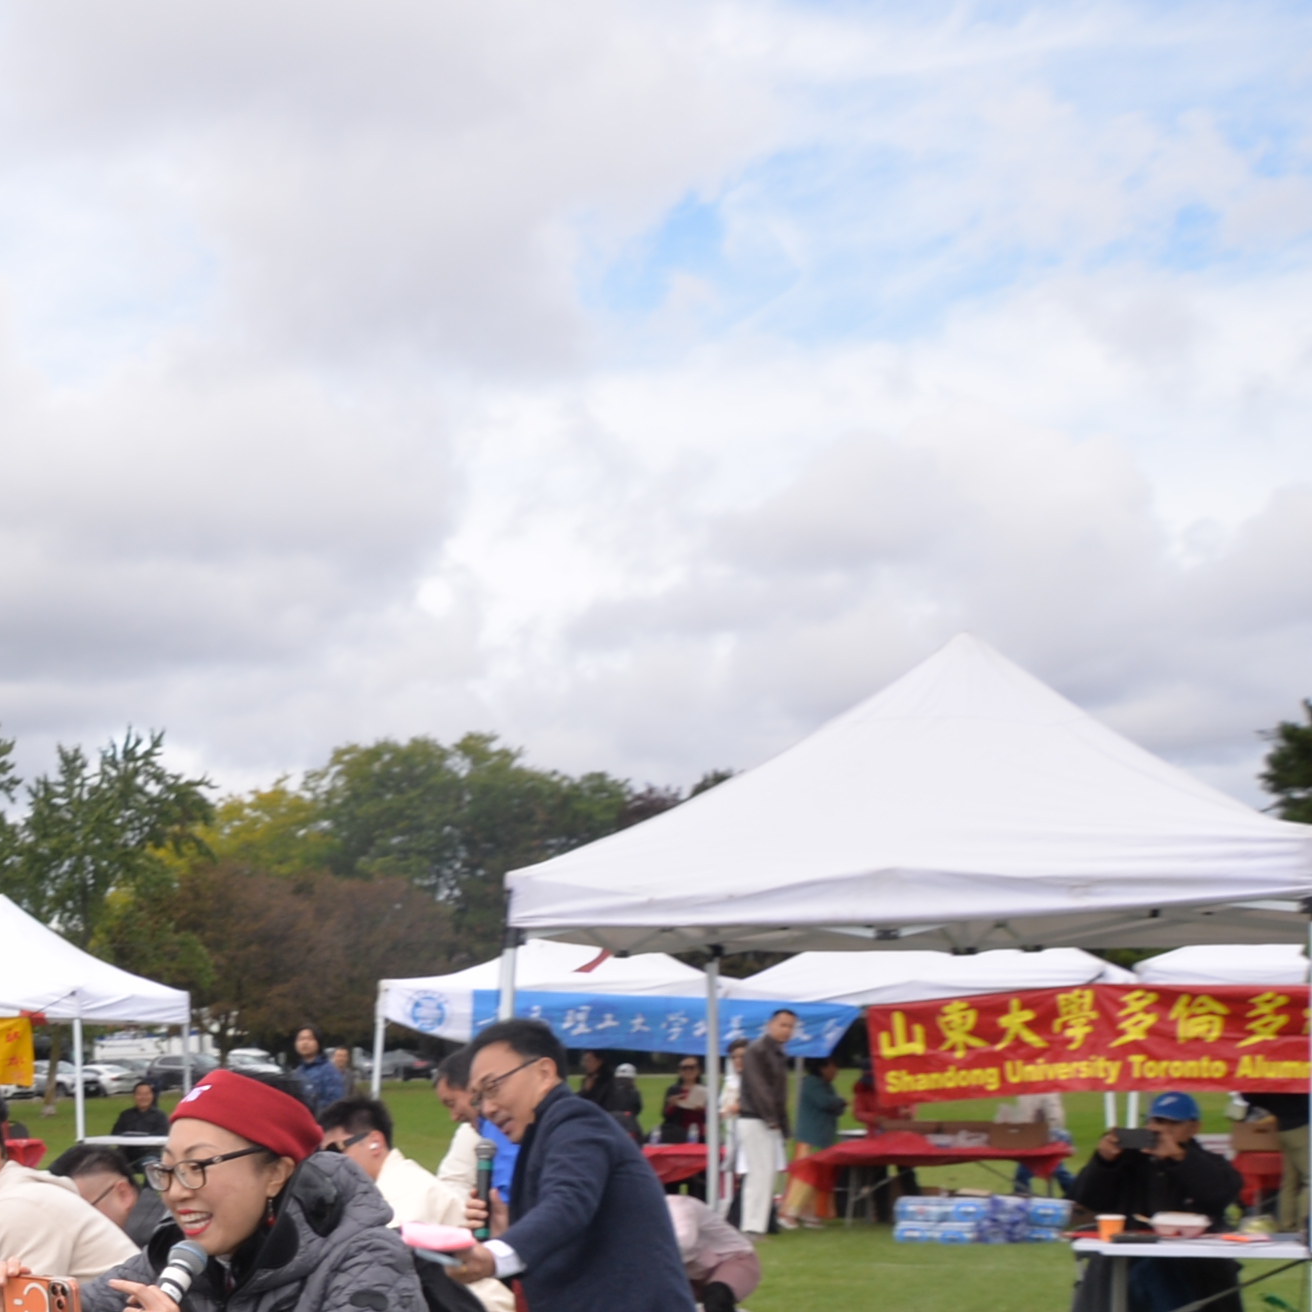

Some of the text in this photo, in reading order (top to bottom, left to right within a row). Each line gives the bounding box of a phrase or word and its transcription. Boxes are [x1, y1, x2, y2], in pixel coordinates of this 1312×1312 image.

[885, 1066, 1000, 1092] Shandong
[1005, 1056, 1122, 1084] University
[1128, 1055, 1227, 1080] Toronto
